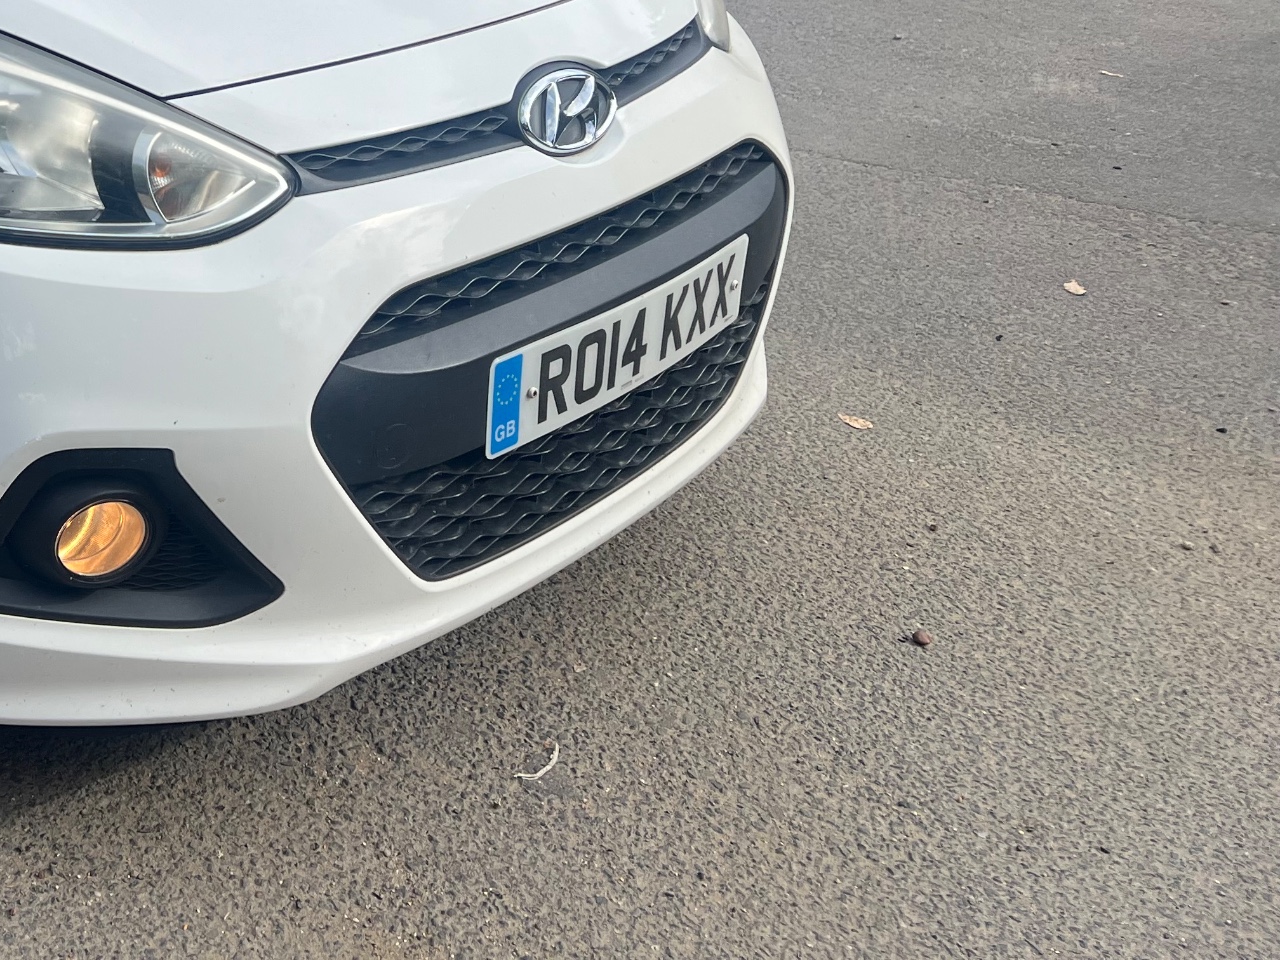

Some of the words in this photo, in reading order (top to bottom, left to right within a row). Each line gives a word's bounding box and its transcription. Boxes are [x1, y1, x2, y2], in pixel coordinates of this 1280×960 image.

[537, 307, 648, 424] RO14
[659, 253, 736, 361] KXX
[494, 419, 516, 443] GB
